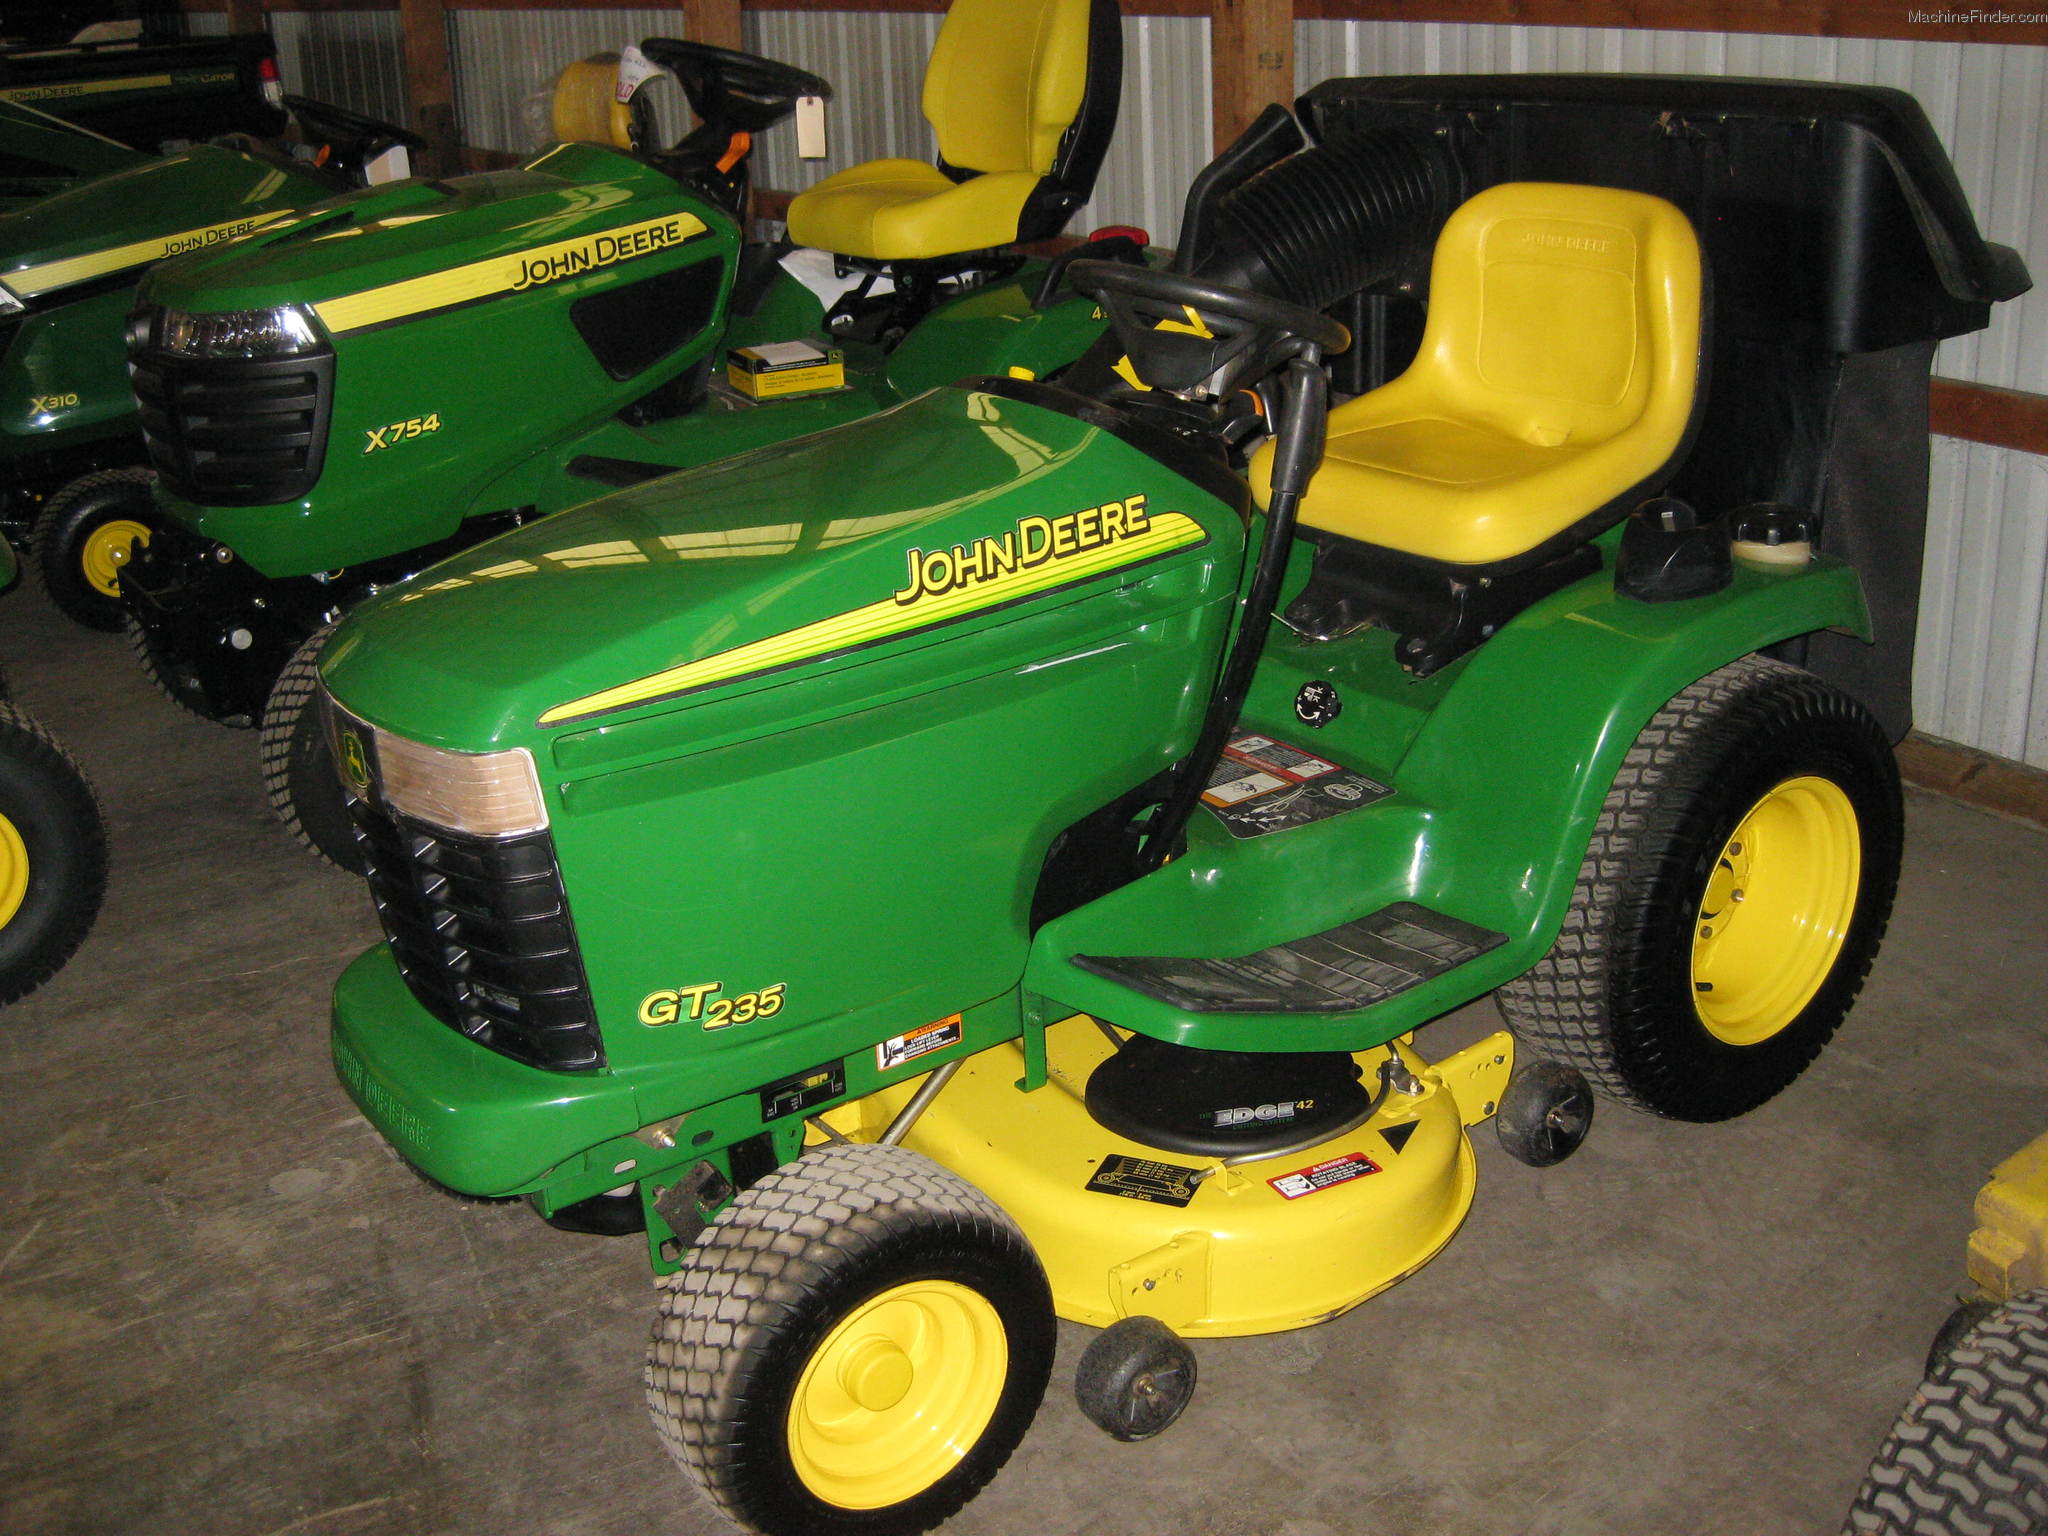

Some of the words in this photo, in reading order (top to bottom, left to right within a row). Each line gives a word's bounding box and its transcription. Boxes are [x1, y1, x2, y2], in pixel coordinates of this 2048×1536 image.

[161, 235, 202, 257] JOHN
[206, 220, 255, 243] DEERE
[513, 247, 590, 288] JOHN
[595, 221, 682, 263] DEERE
[31, 393, 78, 415] X310
[364, 413, 441, 454] X754
[895, 530, 1015, 605] JOHN
[1017, 494, 1151, 569] DEERE
[1214, 1102, 1294, 1127] EDGE
[1296, 1099, 1314, 1110] 42
